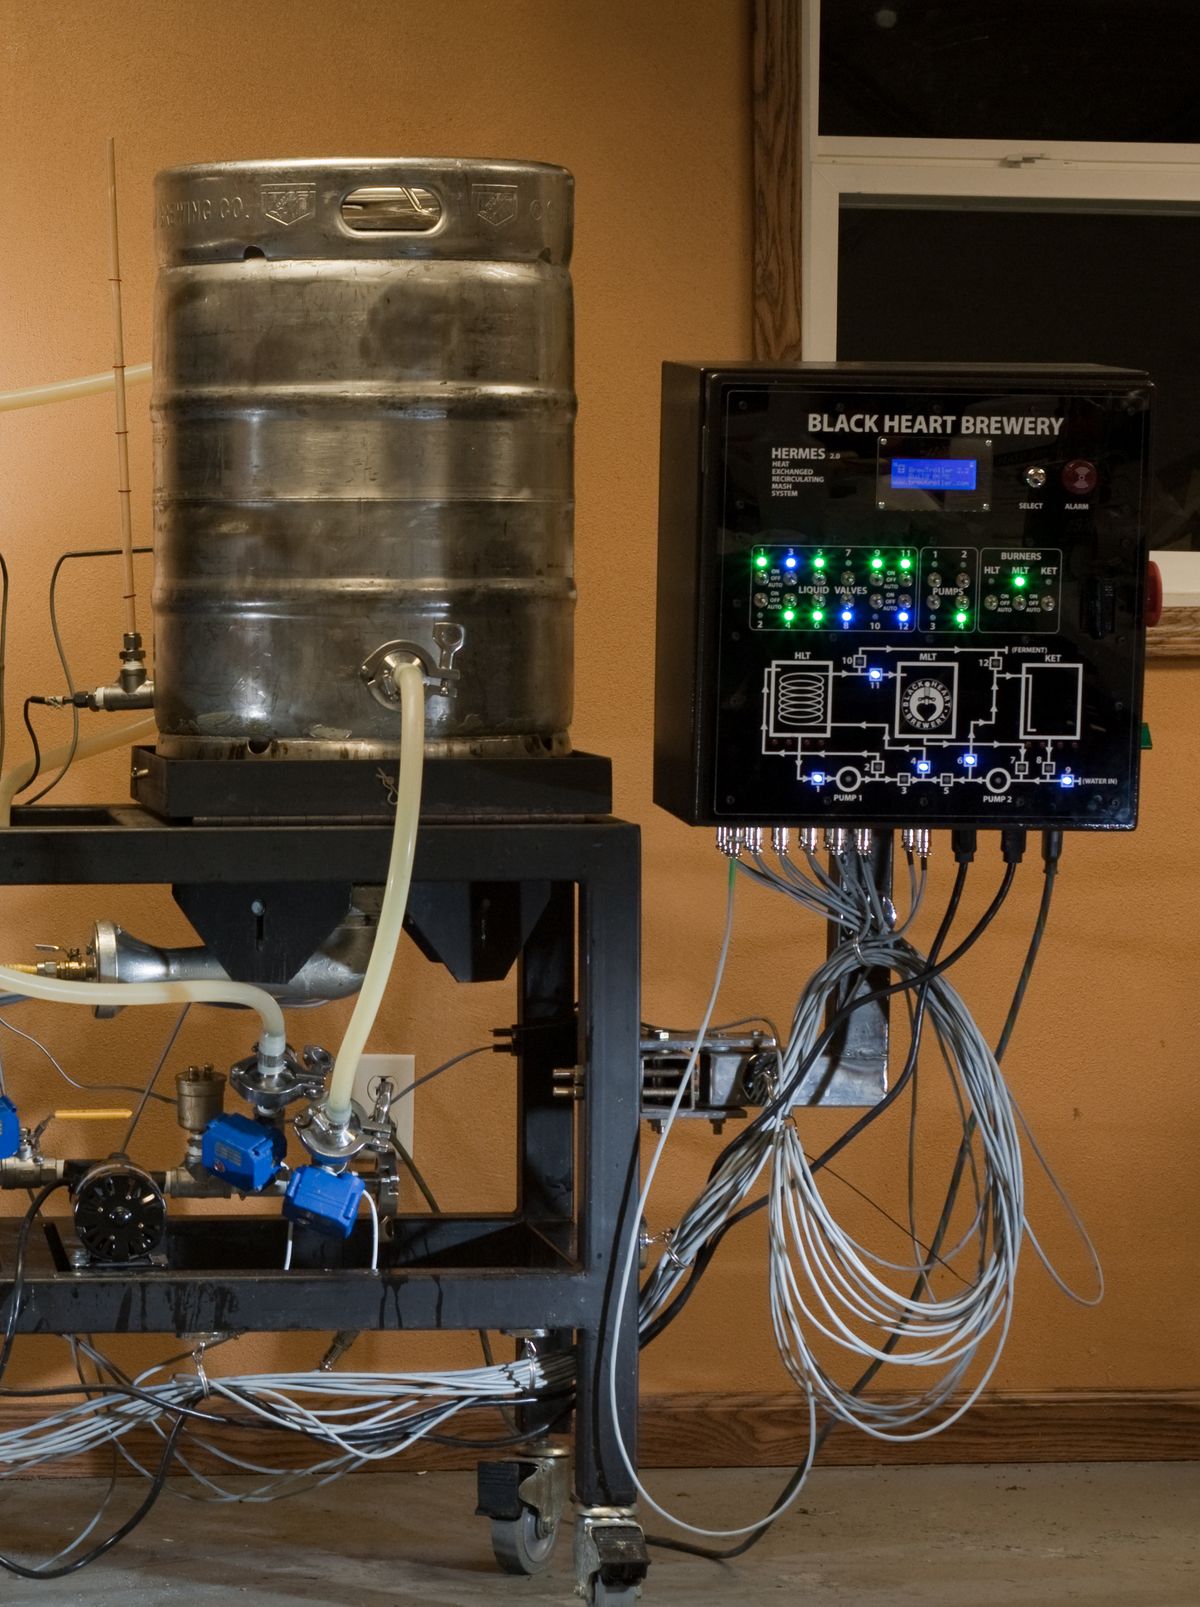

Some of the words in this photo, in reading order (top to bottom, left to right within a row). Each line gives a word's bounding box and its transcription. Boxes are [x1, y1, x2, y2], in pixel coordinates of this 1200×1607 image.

[808, 413, 879, 432] BLACK
[884, 414, 956, 434] HEART
[960, 416, 1064, 436] BREWERY
[771, 447, 826, 460] HERMES
[1001, 552, 1042, 560] BURNERS
[1012, 566, 1030, 575] MLT
[798, 586, 829, 594] LIQUID
[834, 586, 868, 594] VALVES
[903, 681, 924, 707] BLACK
[931, 681, 951, 707] HEART
[906, 713, 946, 728] BREWERY
